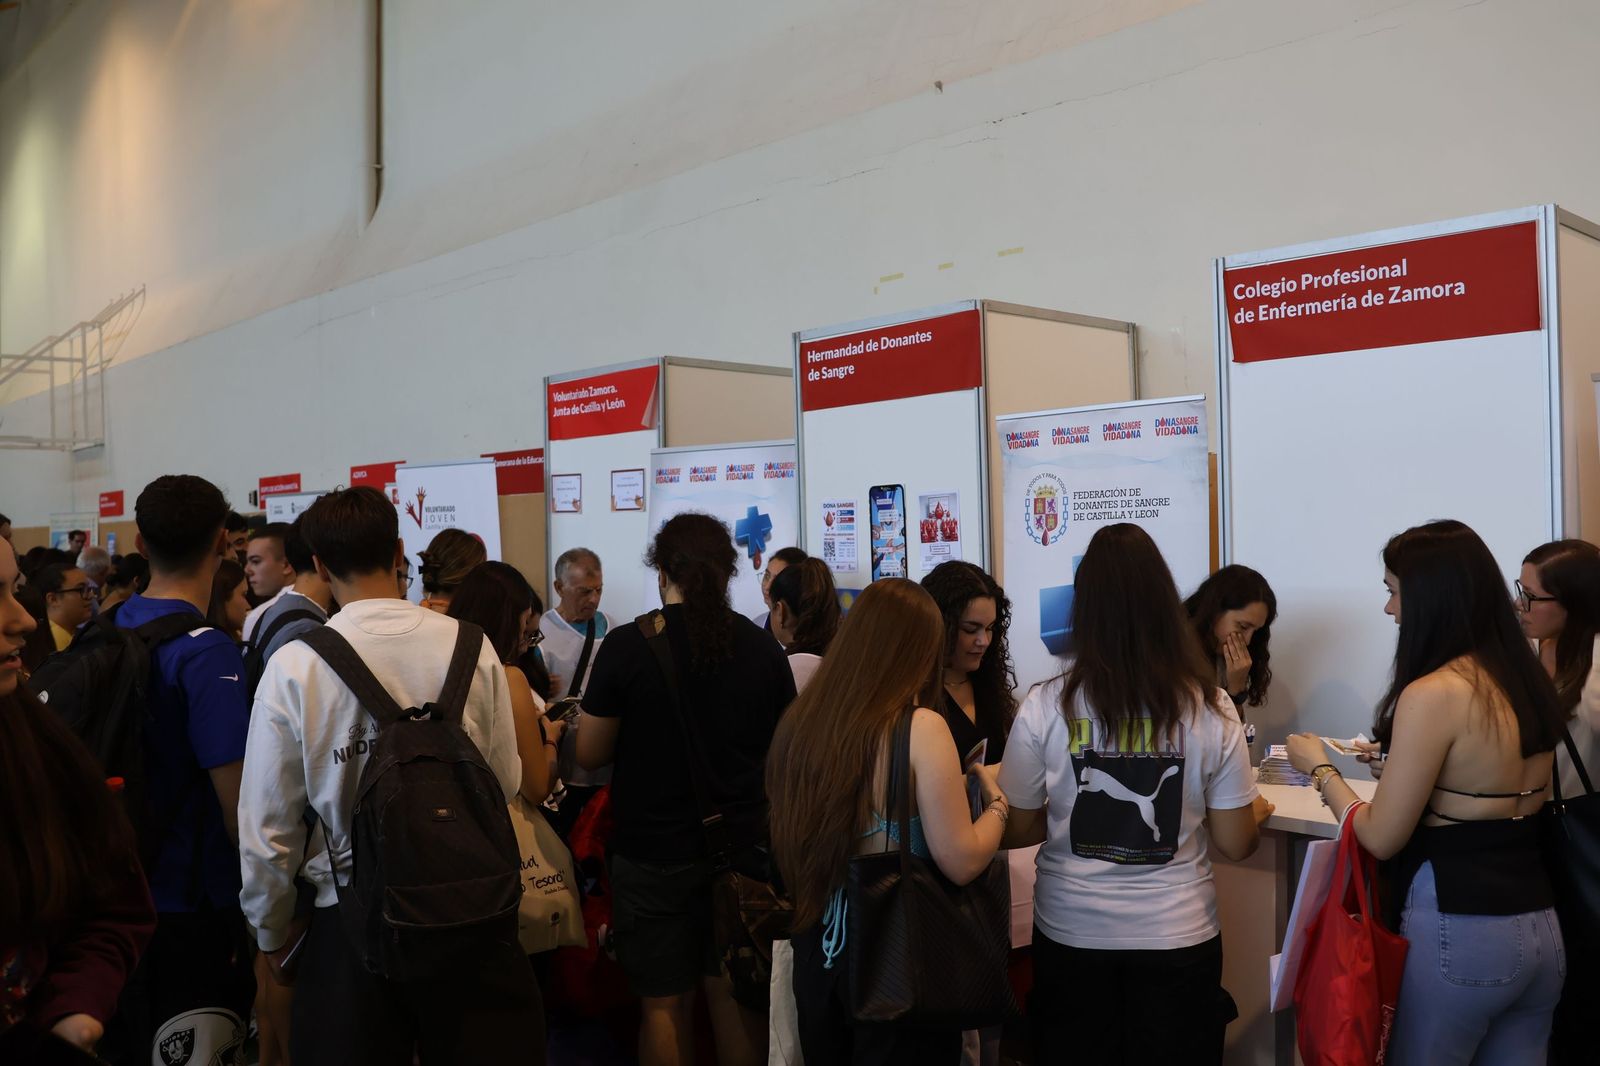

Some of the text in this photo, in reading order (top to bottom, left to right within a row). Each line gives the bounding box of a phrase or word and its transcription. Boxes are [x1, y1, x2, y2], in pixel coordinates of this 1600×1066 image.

[1233, 258, 1407, 301] Colegio Profesional
[1234, 281, 1465, 325] de Enfermería de Zamora
[807, 331, 932, 363] Hermandad de Donantes
[808, 364, 855, 381] de Sangre
[553, 385, 617, 402] Voluntariado Zamora.
[553, 397, 626, 417] Junta de Castilla y León
[1073, 487, 1141, 500] FEDERACIÓN DE
[1073, 497, 1170, 511] DONANTES DE SANGRE
[425, 513, 455, 523] JOVEN
[1073, 509, 1159, 521] DE CASTILLA Y LEON
